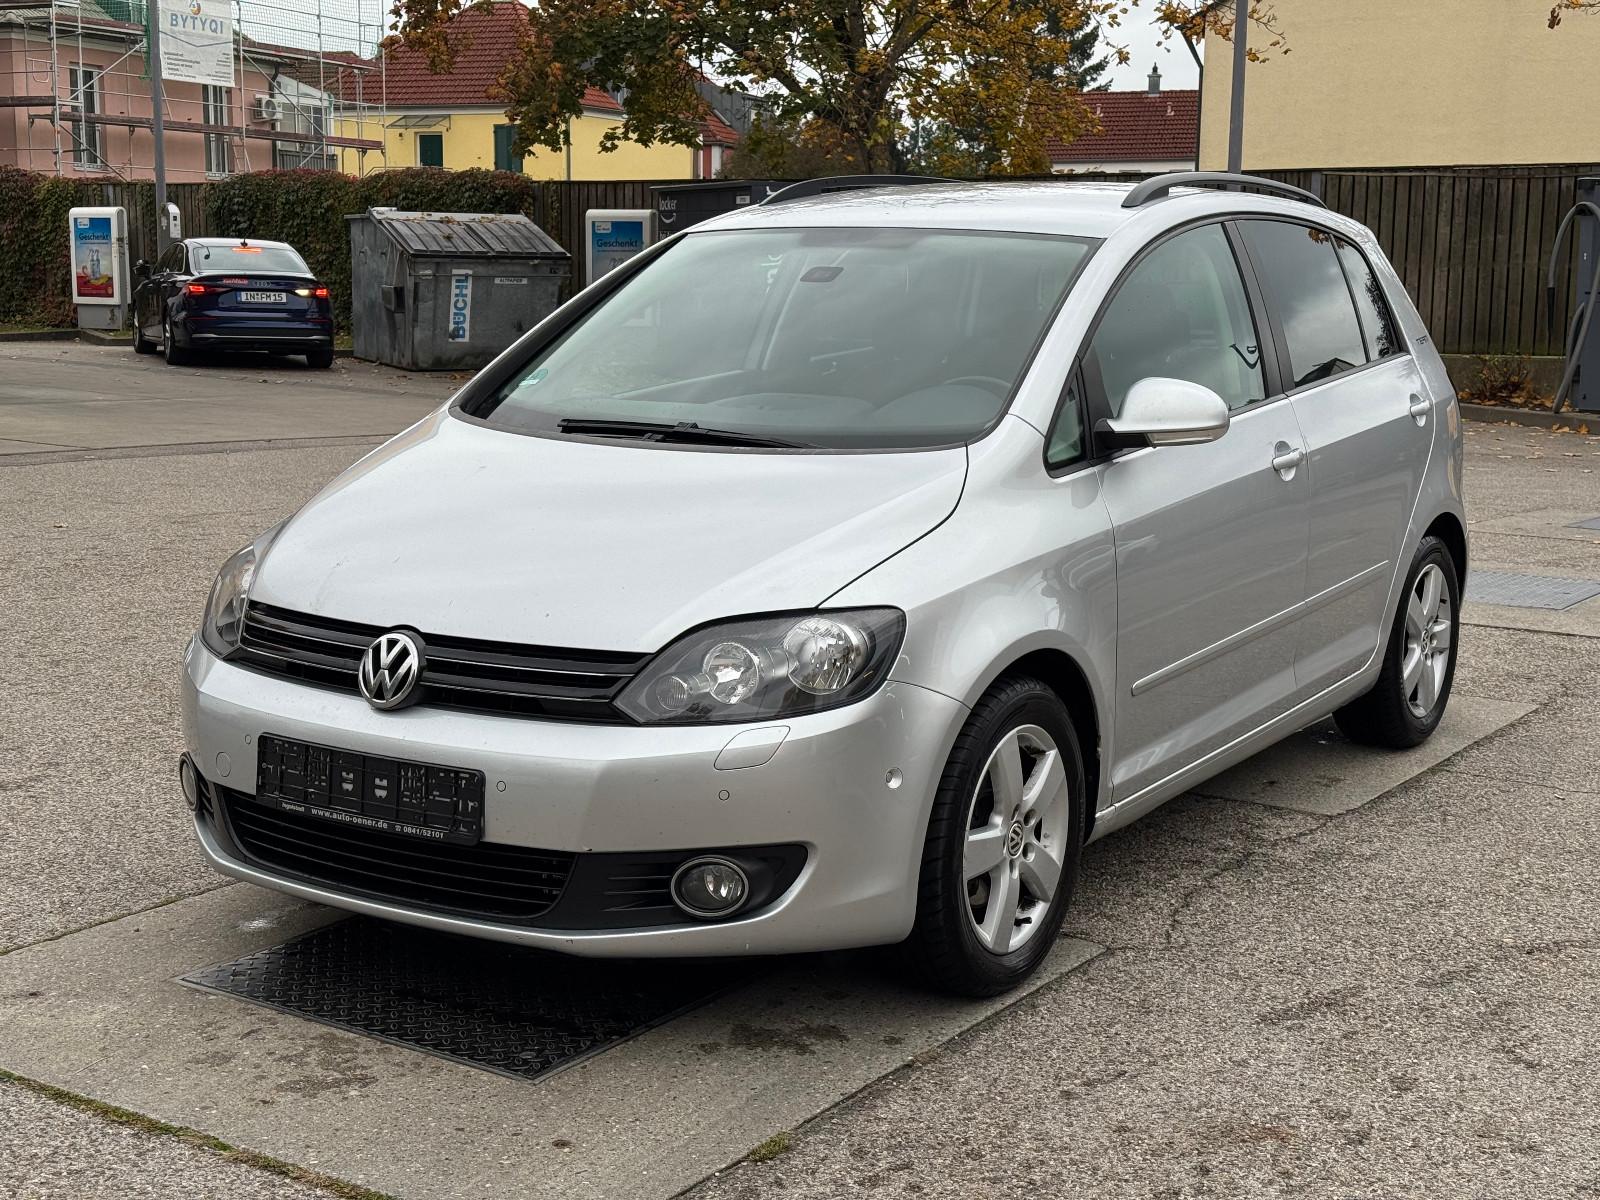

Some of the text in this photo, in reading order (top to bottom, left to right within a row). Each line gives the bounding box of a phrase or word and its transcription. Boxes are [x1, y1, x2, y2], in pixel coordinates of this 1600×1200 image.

[170, 13, 223, 34] BYTYQI
[659, 196, 677, 210] locker
[79, 232, 110, 241] Geschenkt
[596, 238, 638, 248] Geschenkt
[244, 293, 255, 301] IN
[453, 273, 469, 338] BÜCHL
[311, 808, 444, 838] www.auto-oener.de 0841/52101
